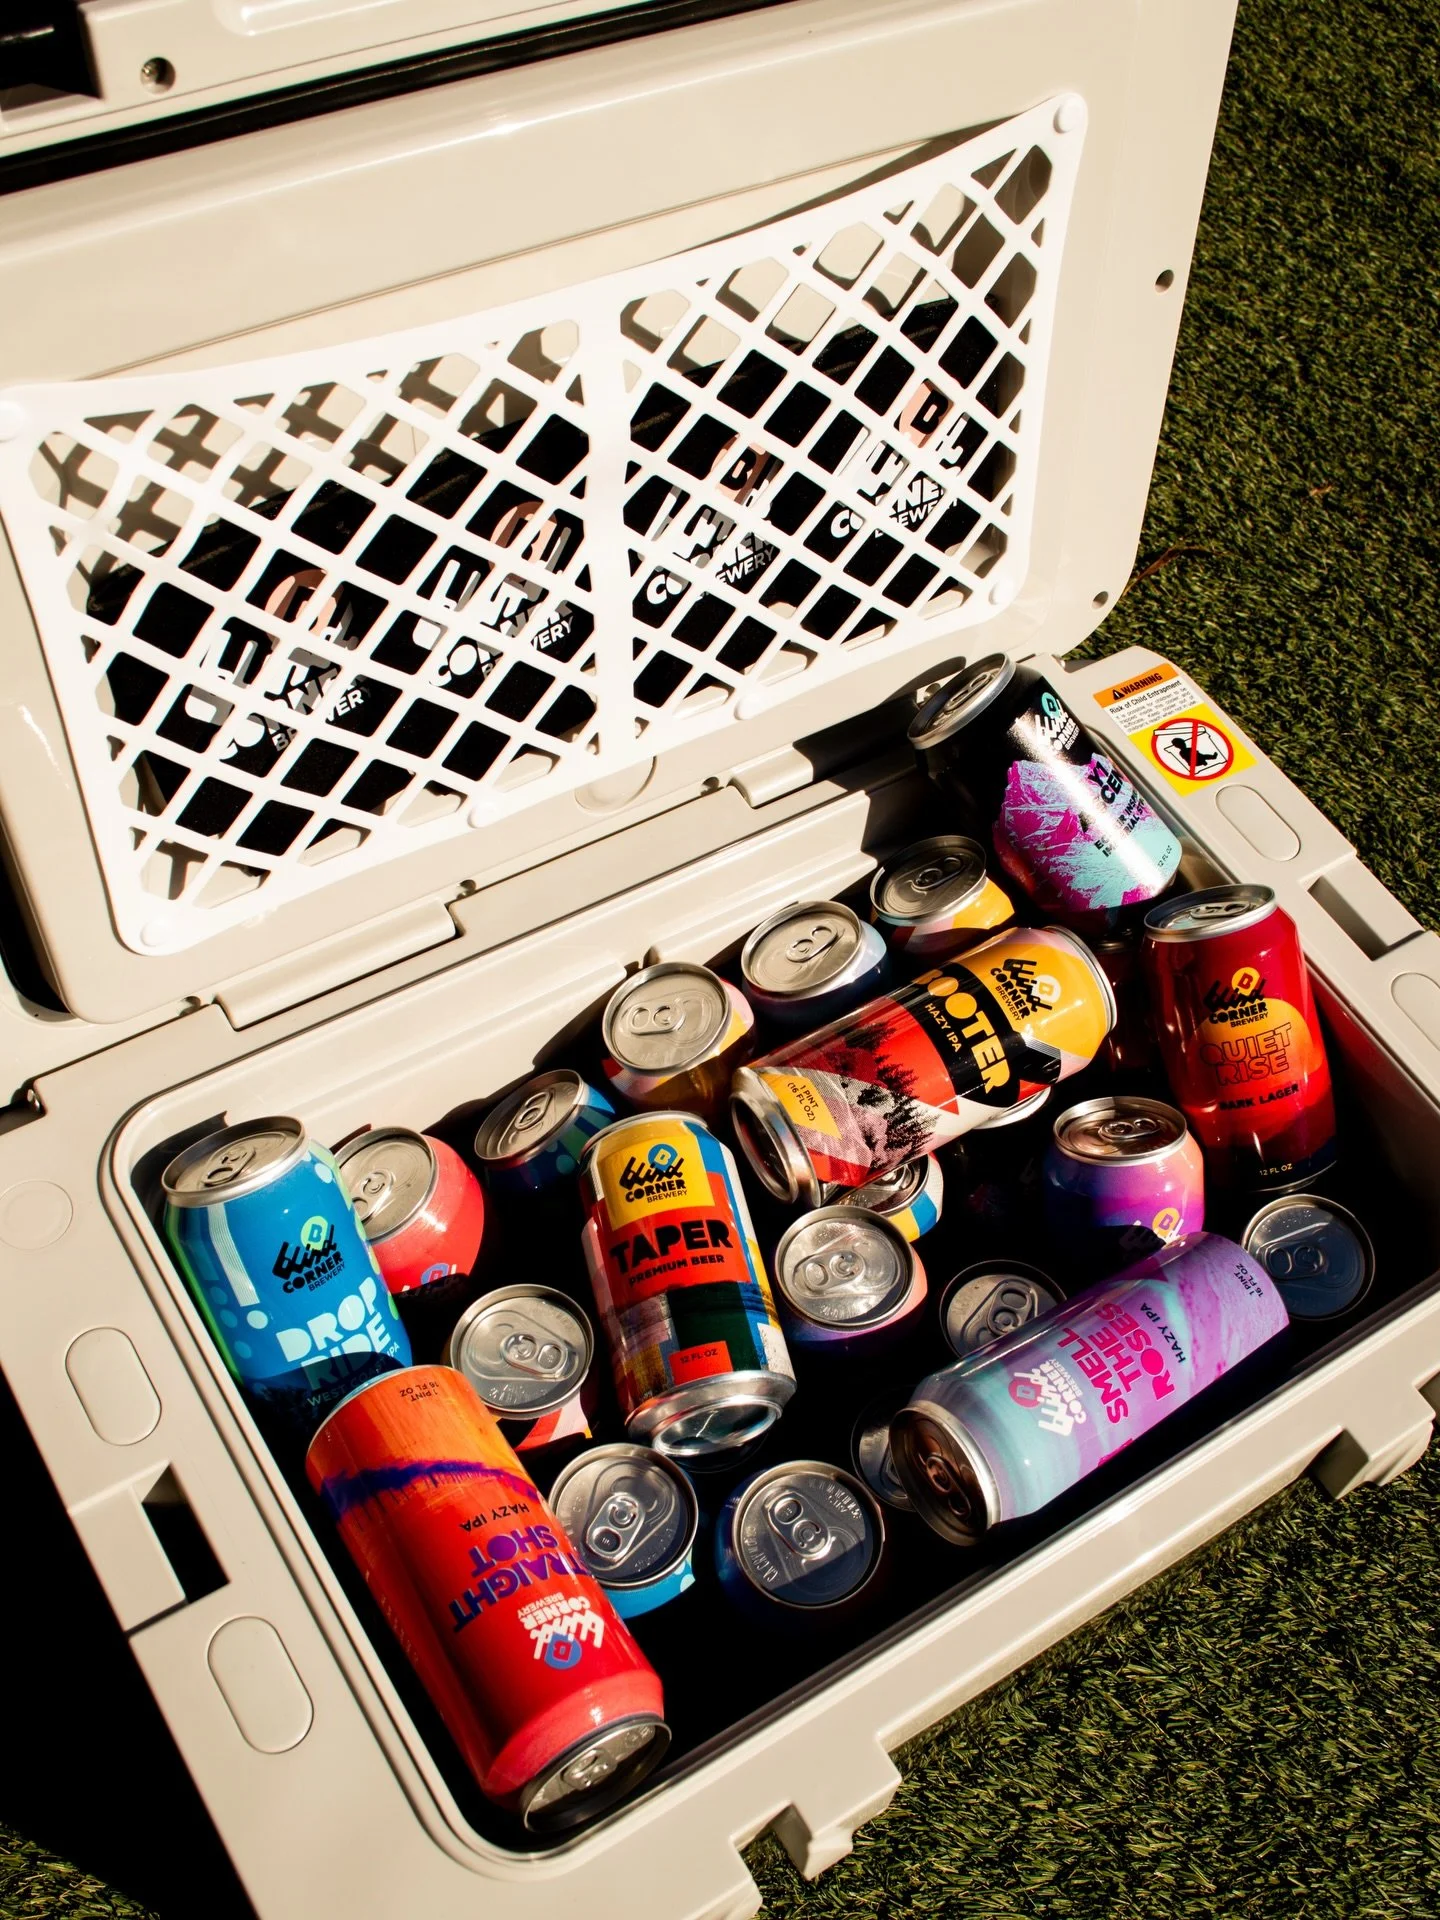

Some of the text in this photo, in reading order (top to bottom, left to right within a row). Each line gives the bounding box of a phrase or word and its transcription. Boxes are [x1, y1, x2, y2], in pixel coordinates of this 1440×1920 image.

[1108, 704, 1124, 714] Risk
[1129, 694, 1147, 705] Child
[1145, 680, 1182, 698] Entrapment
[1121, 672, 1163, 694] WARNING
[990, 967, 1031, 1019] CORNER
[995, 985, 1021, 1022] BREWERY
[924, 1003, 962, 1053] HAZY IPA
[1209, 1001, 1268, 1024] CORNER
[1230, 1012, 1269, 1028] BREWERY
[1200, 1022, 1292, 1066] QUIET
[1216, 1048, 1289, 1086] RISE
[787, 1082, 816, 1121] (16 FL OZ)
[803, 1089, 818, 1108] PINT
[1220, 1083, 1299, 1110] DARK LAGER
[619, 1156, 684, 1190] blind
[1281, 1163, 1293, 1171] OZ
[625, 1179, 686, 1203] CORNER
[647, 1190, 688, 1204] BREWERY
[272, 1224, 337, 1280] blind
[609, 1219, 733, 1274] TAPER
[282, 1251, 344, 1294] CORNER
[308, 1262, 346, 1293] BREWERY
[628, 1254, 725, 1286] PREMIUM BEER
[1234, 1272, 1251, 1291] PINT
[1236, 1263, 1264, 1298] 16 FL OZ
[276, 1277, 377, 1363] DROP
[1141, 1302, 1186, 1363] HAZY IPA
[301, 1312, 391, 1391] RIDE
[388, 1342, 400, 1358] IPA
[691, 1353, 703, 1361] FL
[704, 1349, 718, 1357] OZ
[1088, 1327, 1142, 1393] THE
[1095, 1302, 1175, 1401] ROSES
[400, 1387, 413, 1397] OZ
[1040, 1361, 1087, 1424] CORNER
[1048, 1358, 1083, 1397] BREWERY
[1057, 1327, 1129, 1424] SMELL
[411, 1390, 432, 1402] PINT
[459, 1503, 530, 1533] HAZY IPA
[468, 1525, 558, 1577] SHOT
[449, 1550, 592, 1633] TRAIGHT
[517, 1592, 564, 1619] BREWERY
[520, 1596, 591, 1630] CORNER
[530, 1610, 604, 1660] blind
